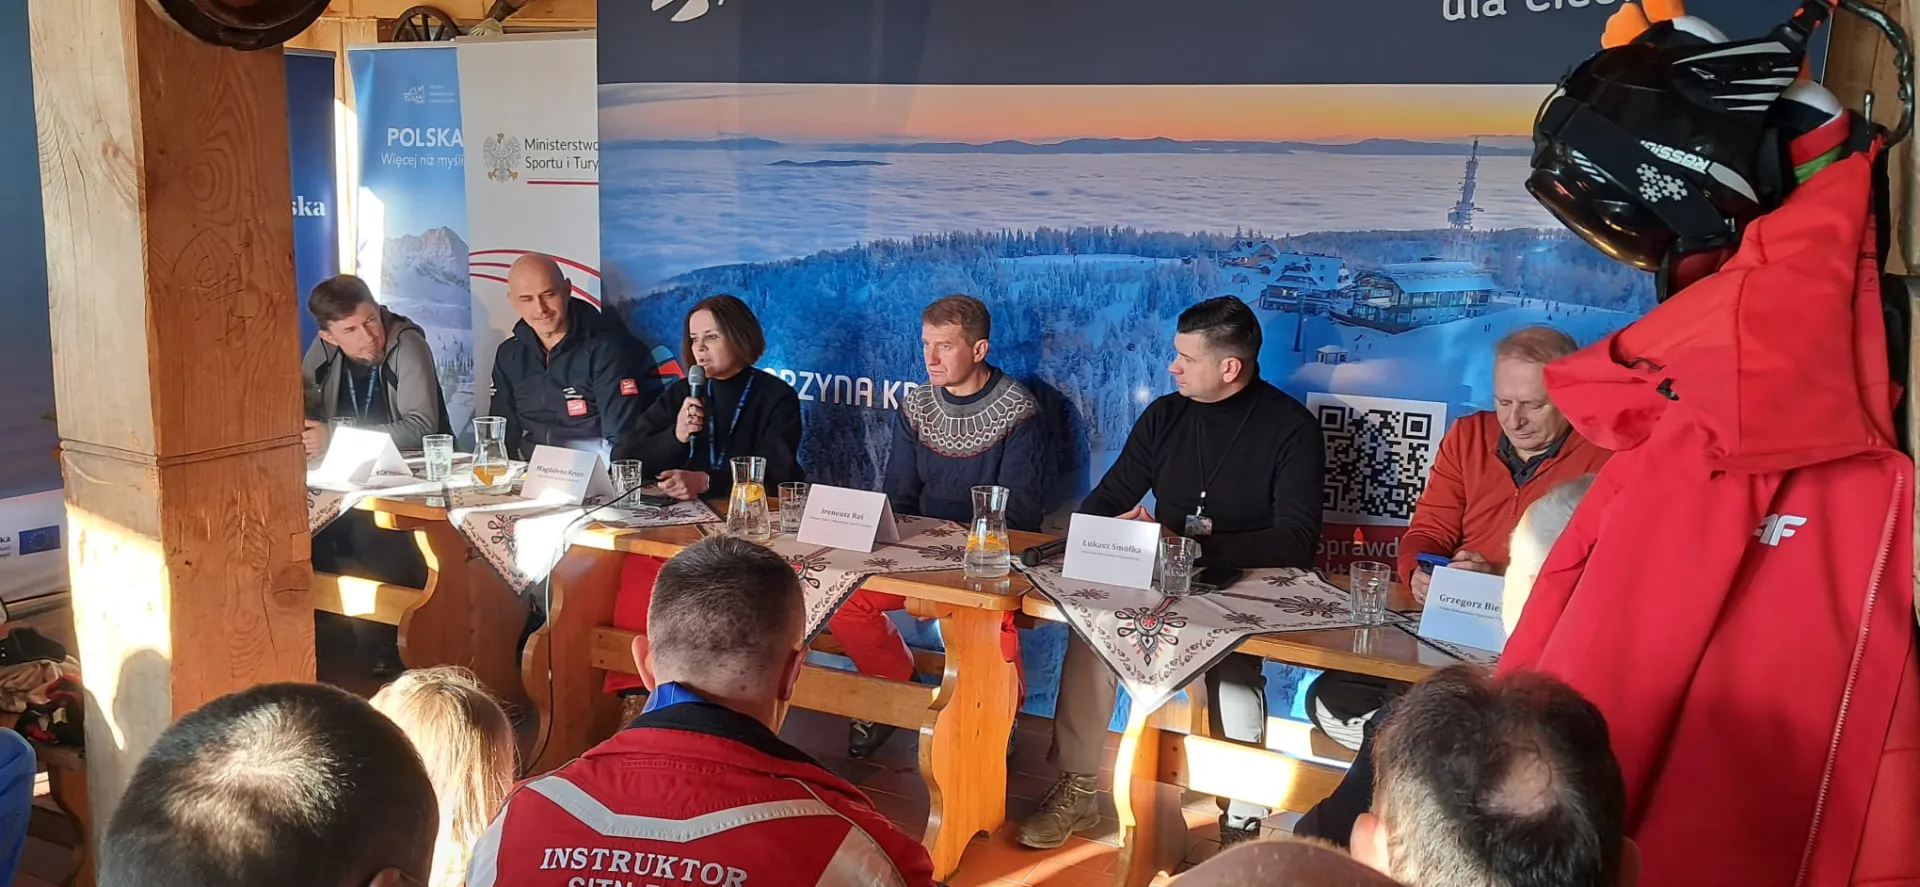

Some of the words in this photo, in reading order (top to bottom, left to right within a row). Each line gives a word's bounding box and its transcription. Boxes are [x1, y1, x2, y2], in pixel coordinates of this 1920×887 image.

[387, 127, 464, 148] POLSKA
[381, 152, 417, 169] Więcej
[420, 153, 435, 166] niż
[525, 156, 563, 170] Sportu
[573, 157, 600, 170] Tury
[821, 507, 851, 519] Ireneusz
[1082, 539, 1111, 550] Łukasz
[1439, 593, 1483, 609] Grzegorz
[1484, 601, 1502, 612] Bie
[540, 847, 748, 887] INSTRUKTOR
